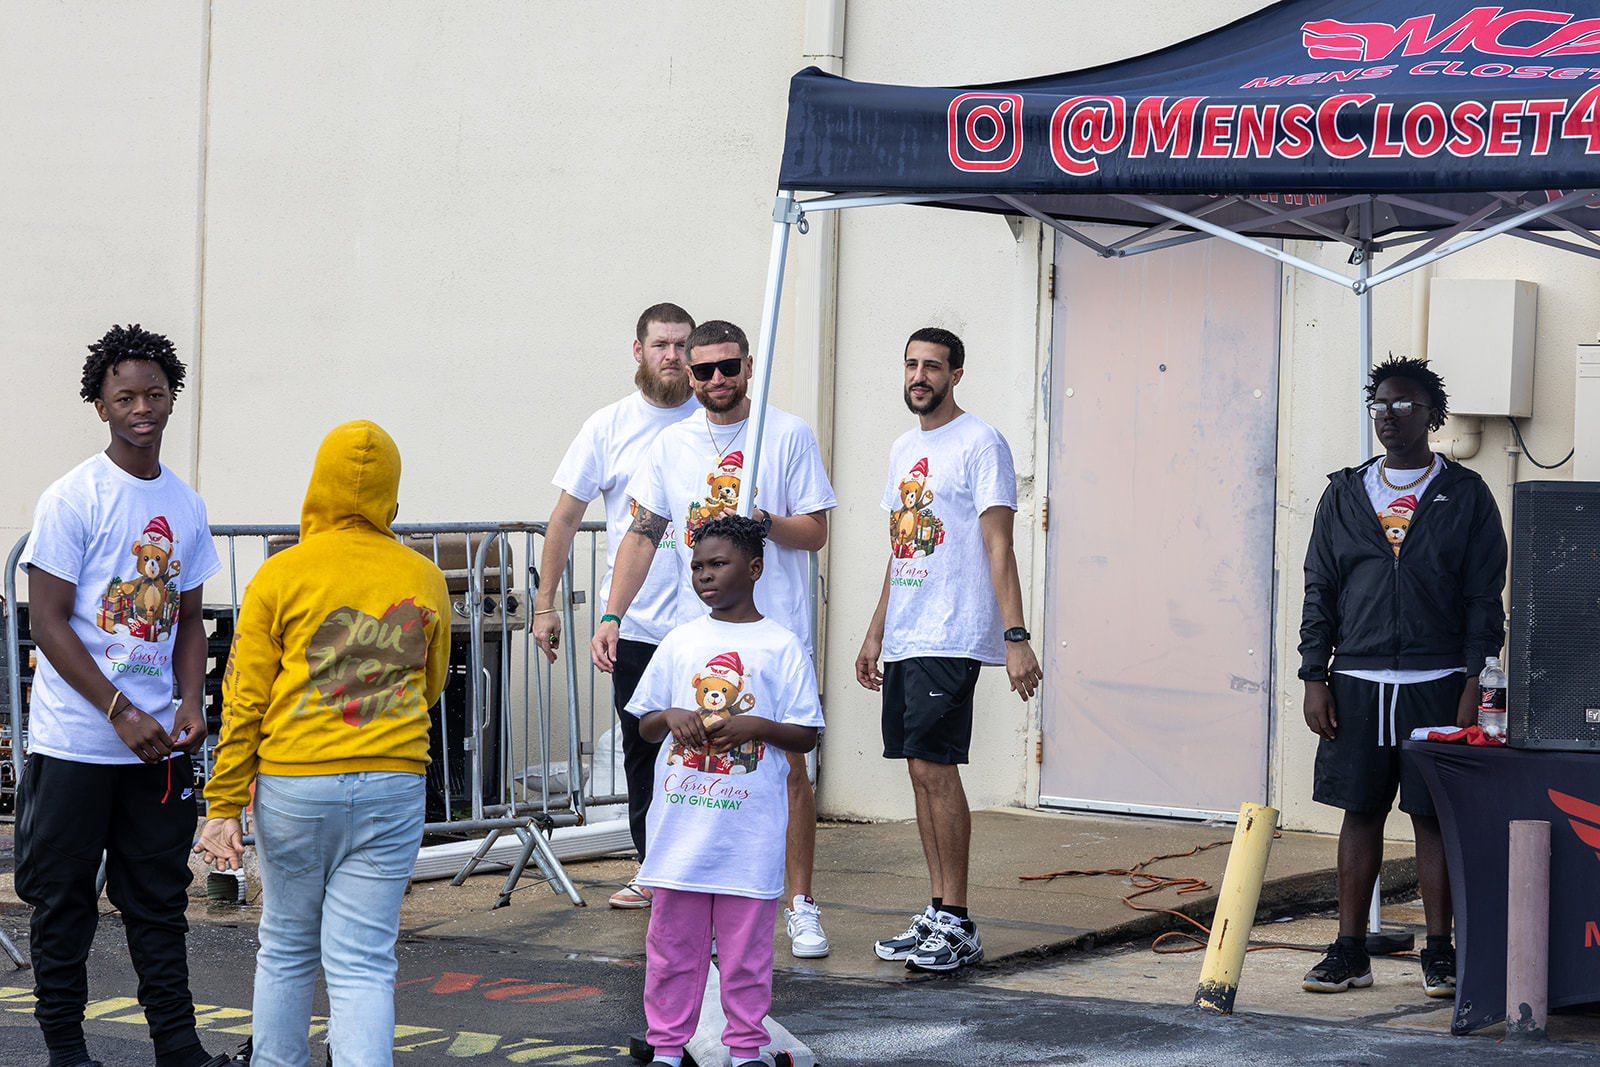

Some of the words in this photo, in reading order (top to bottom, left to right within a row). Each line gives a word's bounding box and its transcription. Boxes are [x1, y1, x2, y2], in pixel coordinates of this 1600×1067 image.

[1239, 64, 1400, 89] MENS
[111, 661, 131, 674] TOY
[132, 664, 163, 677] GIVEA
[664, 773, 752, 799] Christmas
[665, 793, 686, 804] TOY
[688, 795, 743, 810] GIVEAWAY
